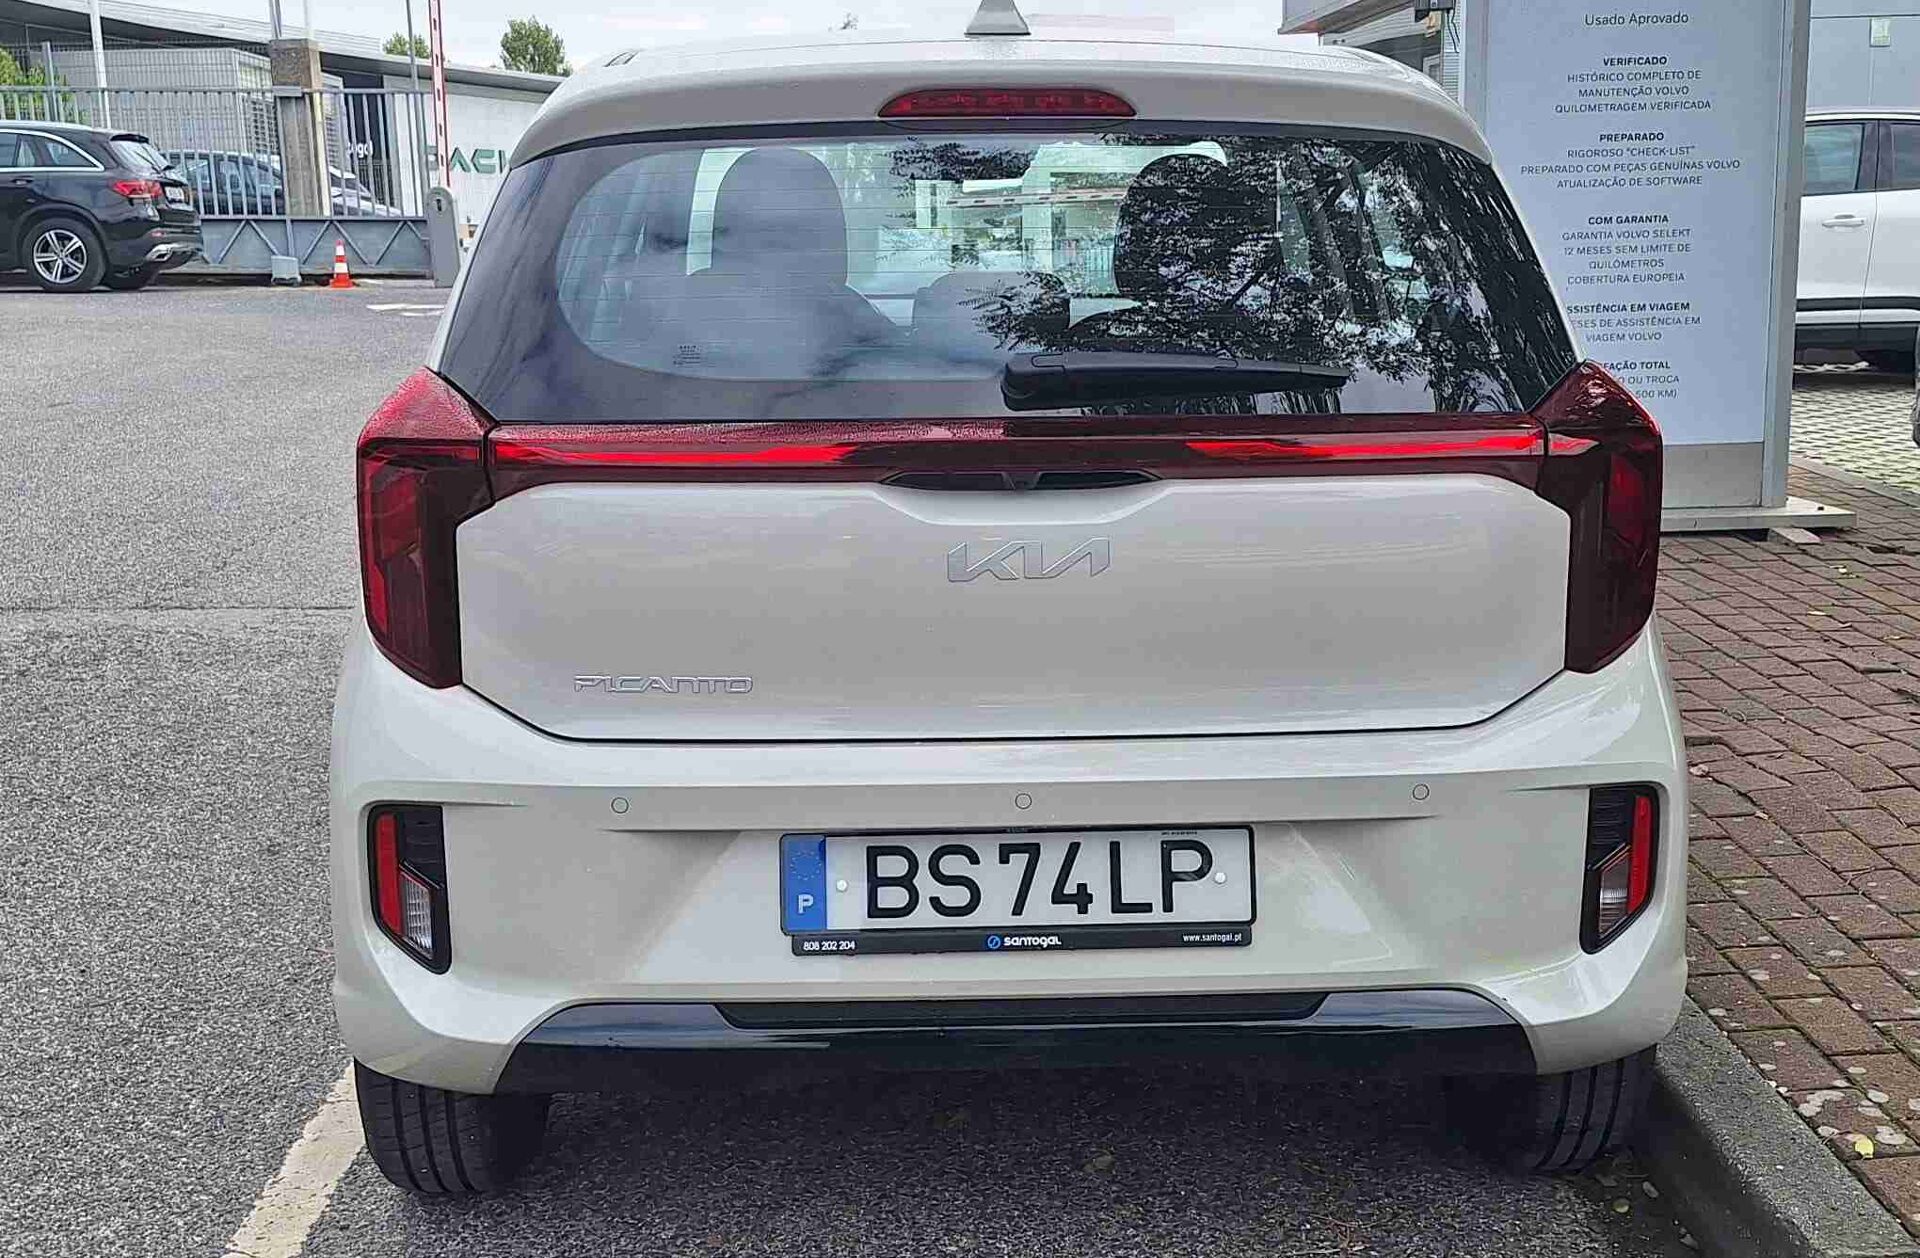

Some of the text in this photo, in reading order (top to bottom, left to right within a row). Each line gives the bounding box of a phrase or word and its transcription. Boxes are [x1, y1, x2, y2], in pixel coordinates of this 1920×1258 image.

[1584, 12, 1689, 27] Usado Aprovado
[1603, 56, 1668, 66] VERIFICADO
[1567, 70, 1702, 83] HISTÓRICO COMPLETO DE
[1578, 86, 1690, 98] MANUTENÇÃO VOLVO
[1555, 100, 1712, 114] QUILOMETRAGEM VERIFICADA
[1599, 132, 1665, 142] PREPARADO
[1567, 145, 1696, 159] RIGOROSO "CHECK-LIST"
[1521, 158, 1741, 175] PREPARADO COM PEÇAS GENUÍNAS VOLVO
[1556, 175, 1703, 189] ATUALIZAÇÃO DE SOFTWARE
[1588, 214, 1669, 225] COM GARANTIA
[1562, 228, 1691, 241] GARANTIA VOLVO SELEKT
[1564, 243, 1691, 256] 12 MESES SEM LIMITE DE
[1567, 272, 1685, 285] COBERTURA EUROPEIA
[1567, 301, 1690, 314] SSISTÊNCIA EM VIAGEM
[1570, 315, 1701, 329] ESES DE ASSISTÊNCIA EM
[1586, 331, 1662, 343] VIAGEM VOLVO
[1639, 360, 1671, 370] TOTAL
[1627, 375, 1643, 385] OU
[1645, 374, 1680, 384] TROCA
[1657, 388, 1677, 398] KM)
[948, 536, 1110, 582] KIA
[573, 675, 753, 694] PICANTO
[798, 894, 814, 914] P
[1003, 936, 1062, 948] santogal
[1182, 932, 1242, 943] www.santogal.pt
[803, 940, 855, 951] 808 202 204
